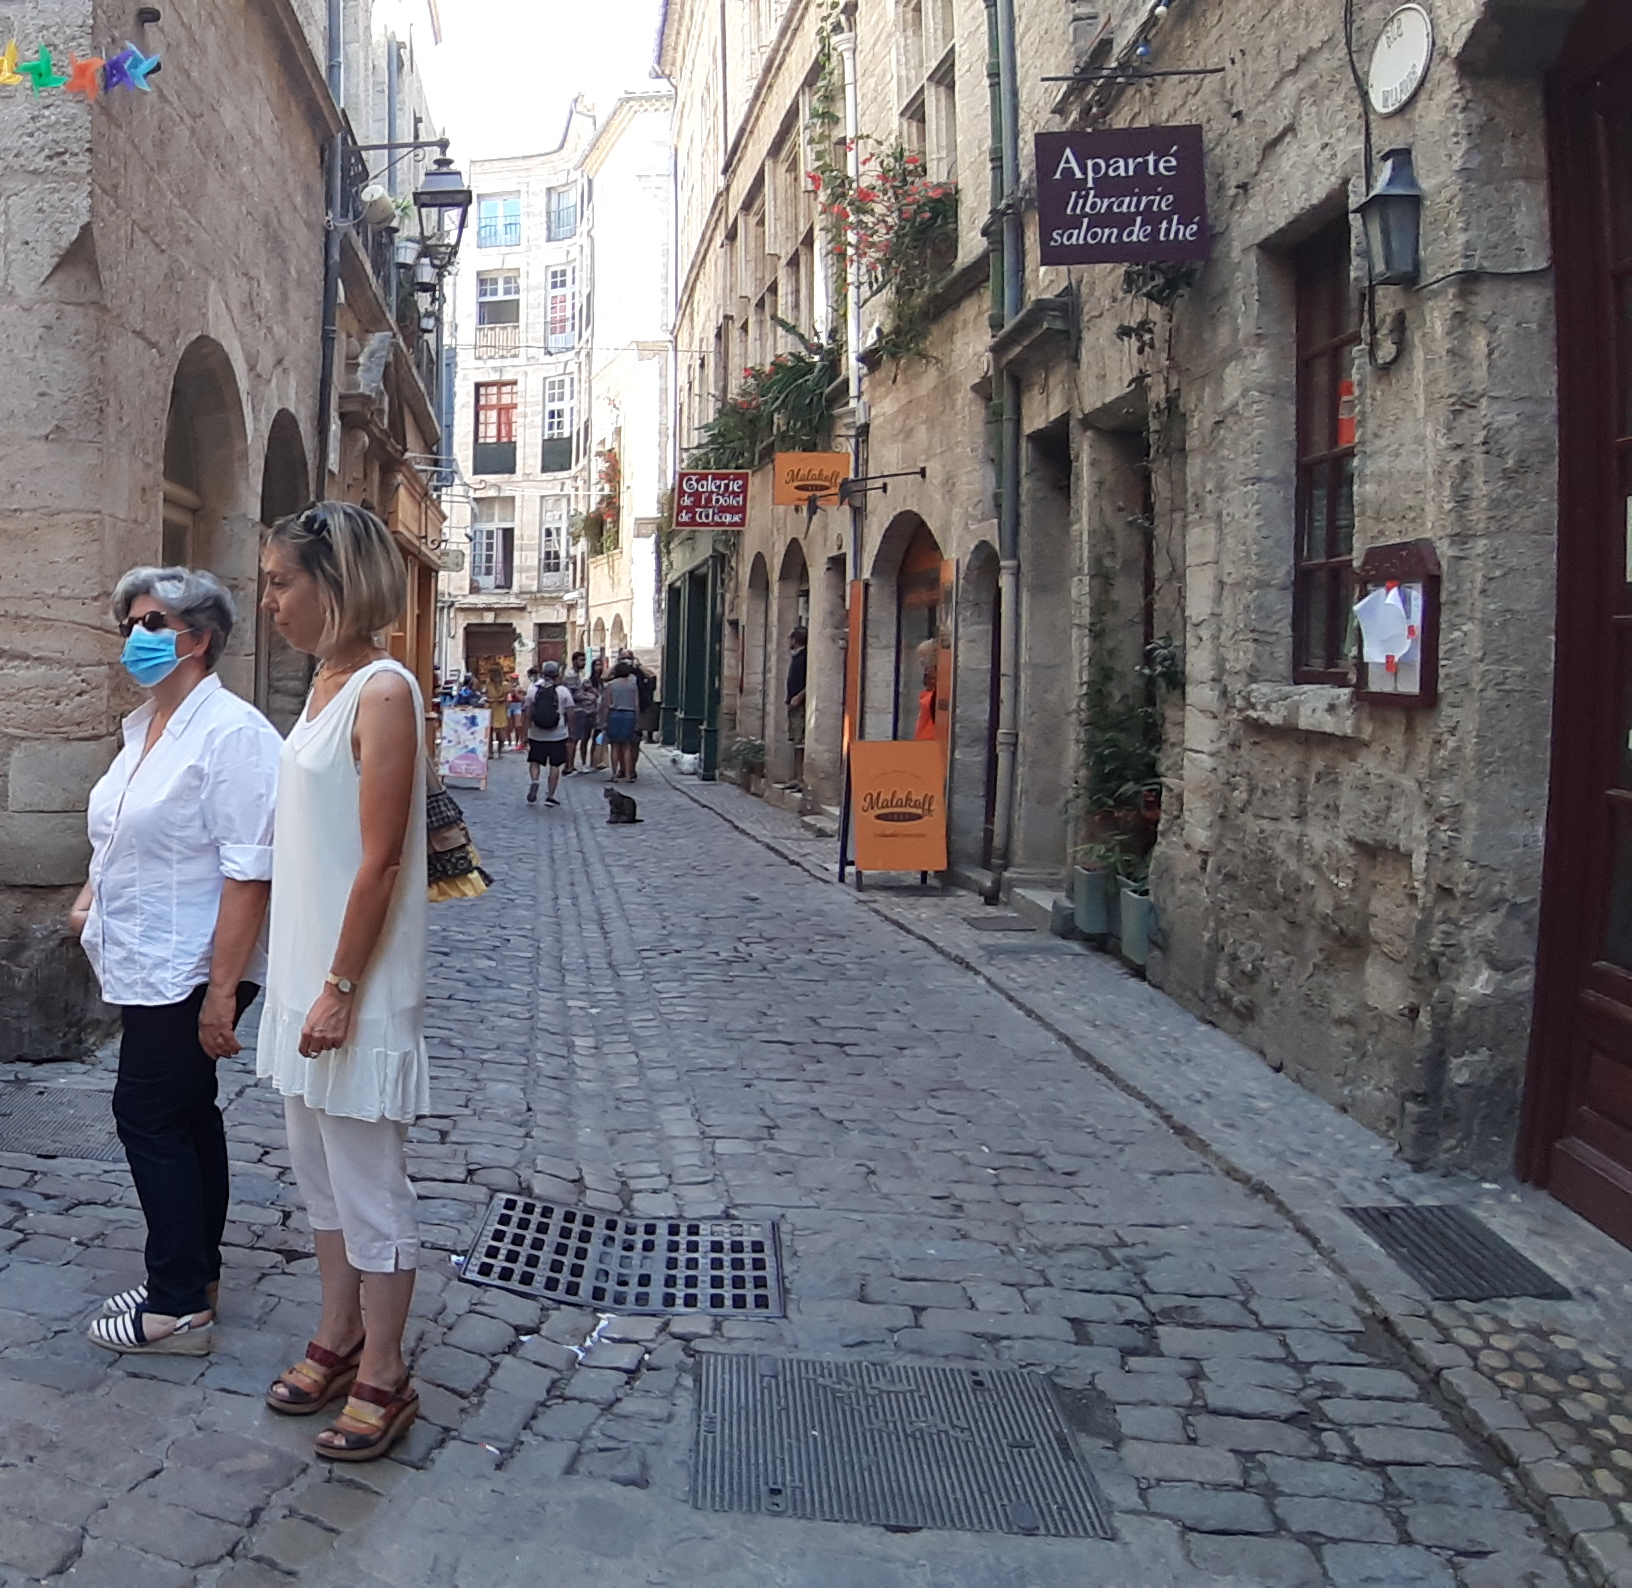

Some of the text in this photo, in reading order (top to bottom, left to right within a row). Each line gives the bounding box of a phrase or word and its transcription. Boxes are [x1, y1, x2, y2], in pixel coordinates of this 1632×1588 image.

[1052, 144, 1178, 188] Aparté
[1066, 187, 1174, 215] librairie
[1050, 214, 1200, 246] salon de thé
[682, 474, 743, 494] Galerie
[680, 493, 694, 506] de
[678, 509, 692, 522] de
[861, 789, 936, 817] Malakoff
